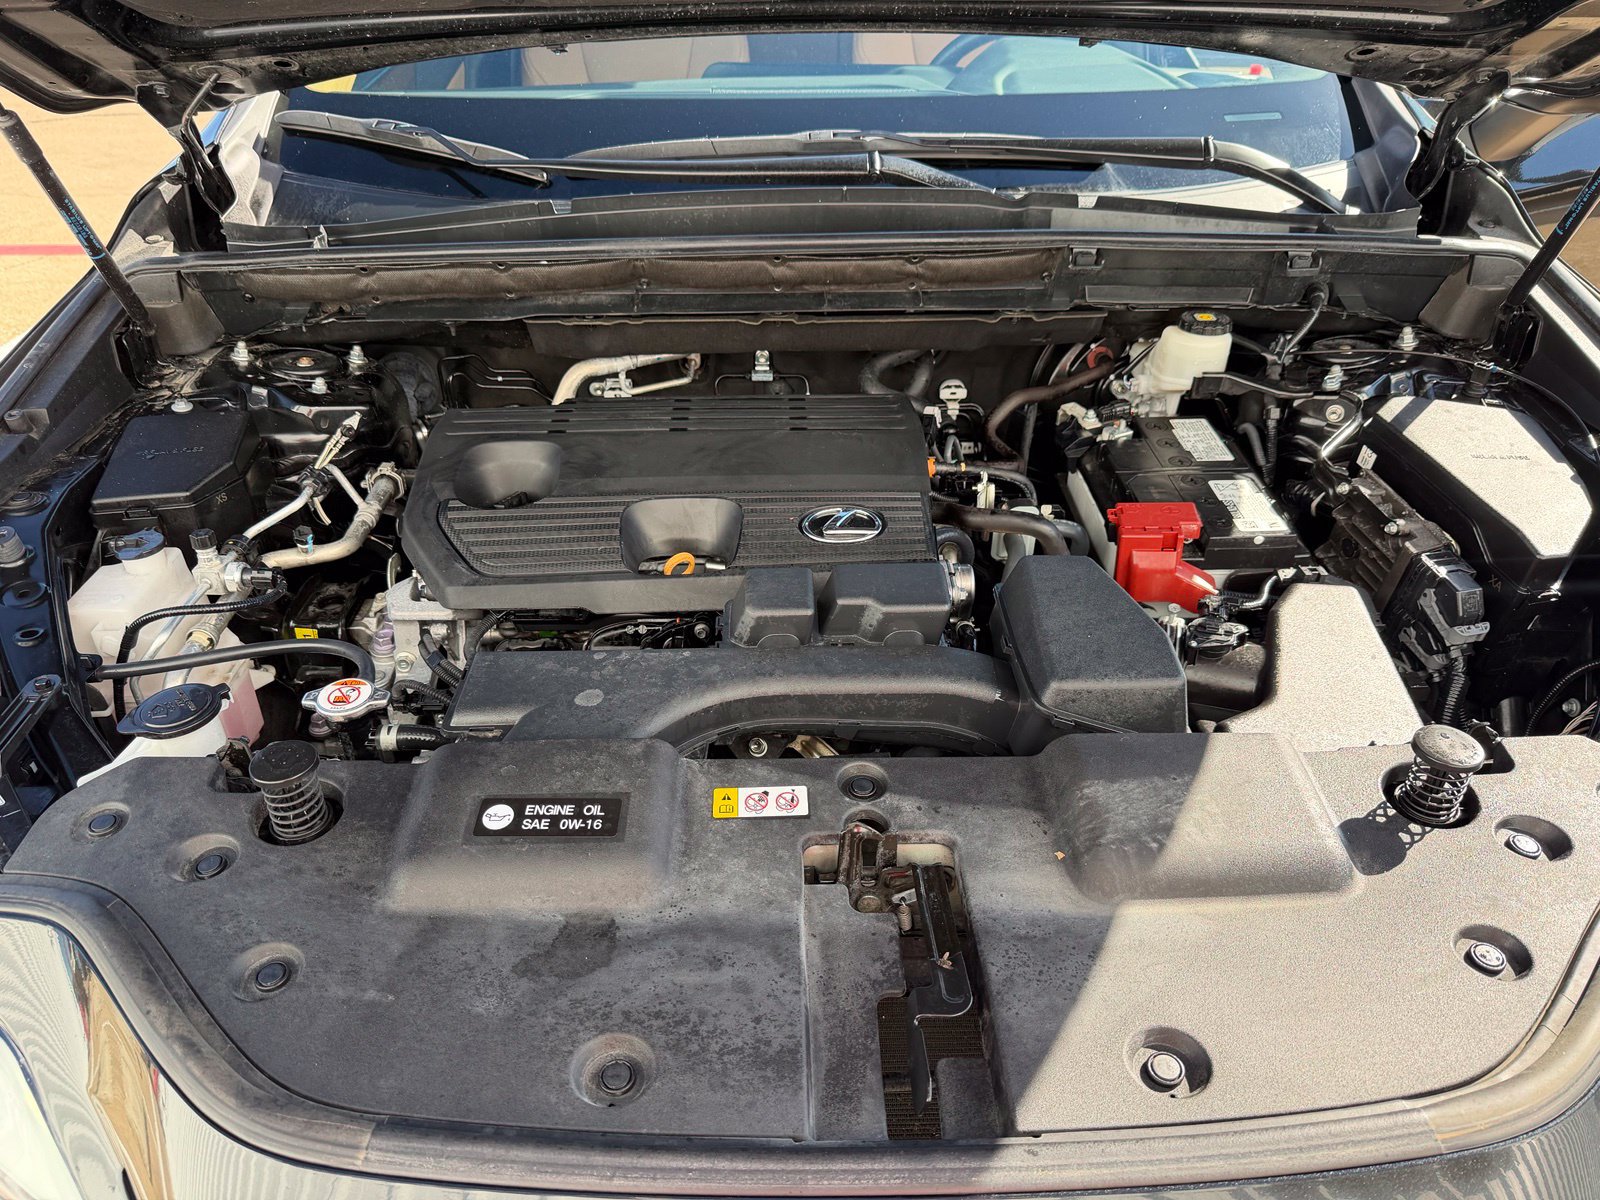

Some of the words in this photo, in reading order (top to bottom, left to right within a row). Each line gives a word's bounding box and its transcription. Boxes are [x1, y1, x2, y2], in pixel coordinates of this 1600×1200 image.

[524, 804, 576, 816] ENGINE
[583, 804, 605, 816] OIL
[521, 818, 550, 830] SAE
[559, 818, 603, 830] 0W-16
